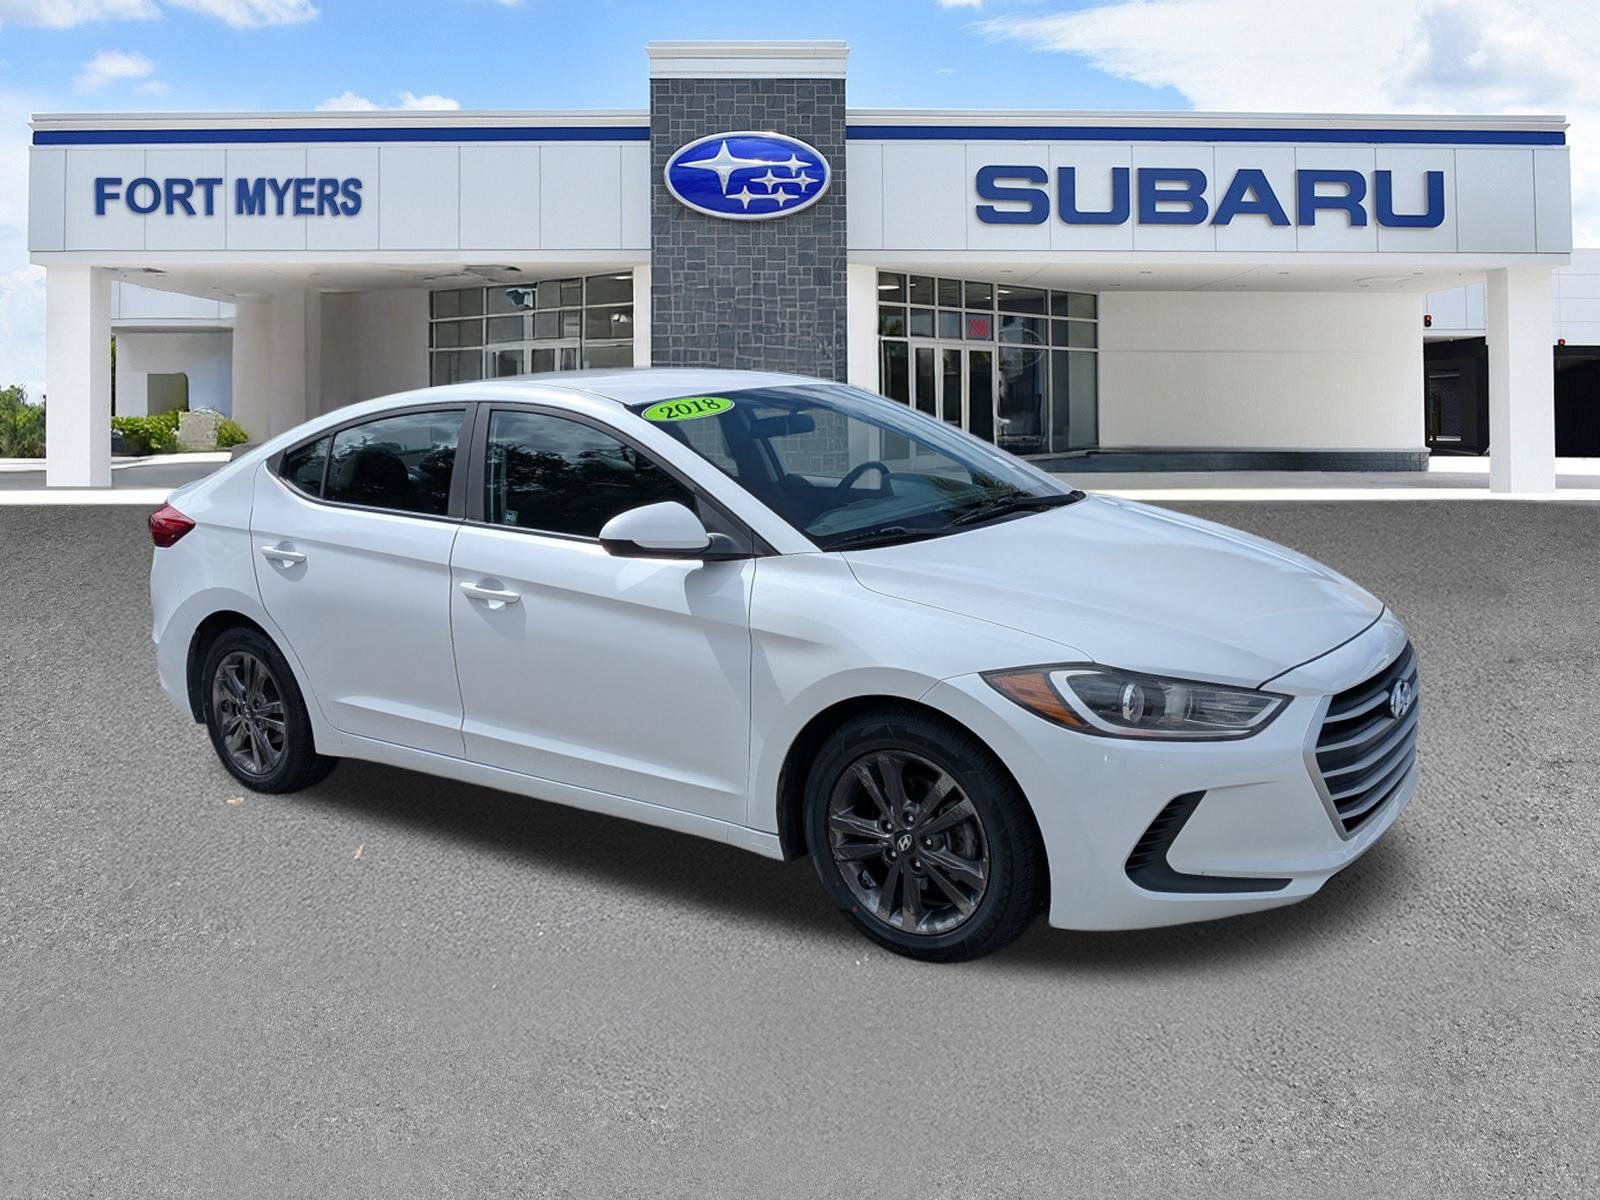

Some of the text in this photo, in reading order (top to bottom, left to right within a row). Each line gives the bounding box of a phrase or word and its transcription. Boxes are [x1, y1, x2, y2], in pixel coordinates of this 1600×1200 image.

[94, 177, 363, 216] FORT MYERS
[975, 165, 1445, 228] SUBARU
[659, 398, 721, 419] 2018
